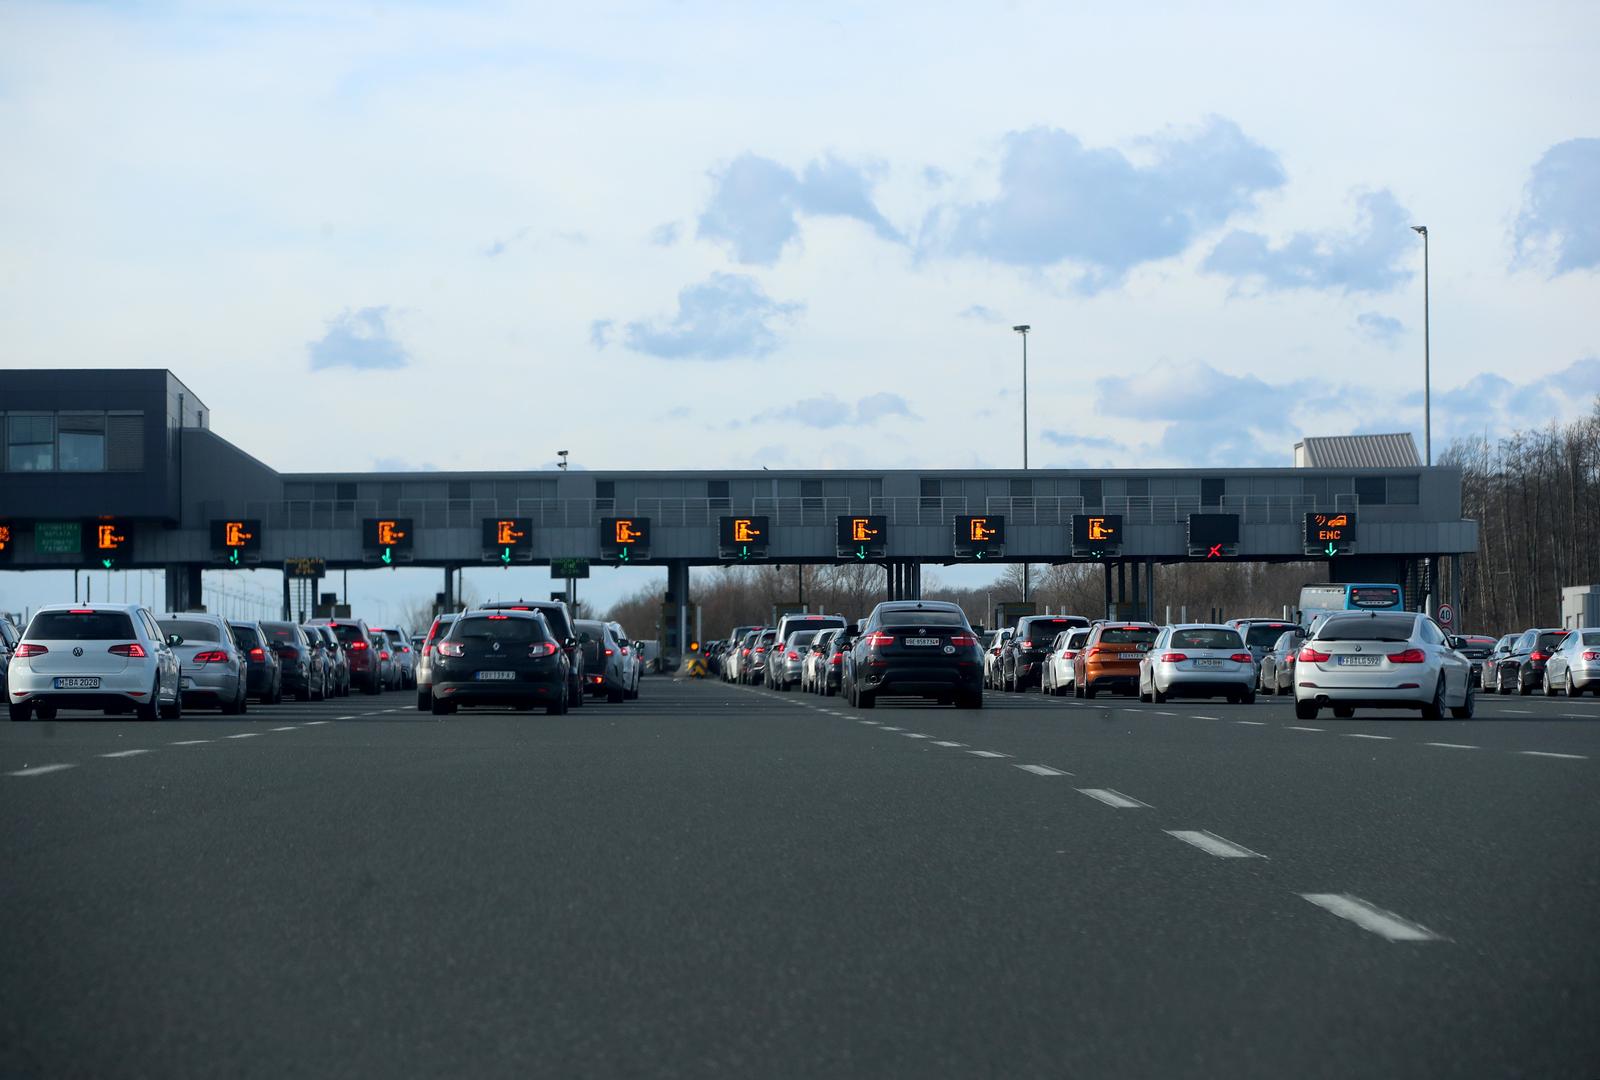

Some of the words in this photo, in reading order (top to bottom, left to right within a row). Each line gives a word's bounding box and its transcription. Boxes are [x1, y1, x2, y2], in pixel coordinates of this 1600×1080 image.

[1319, 530, 1341, 540] ENC
[1440, 610, 1451, 620] 40
[79, 678, 98, 687] 2028
